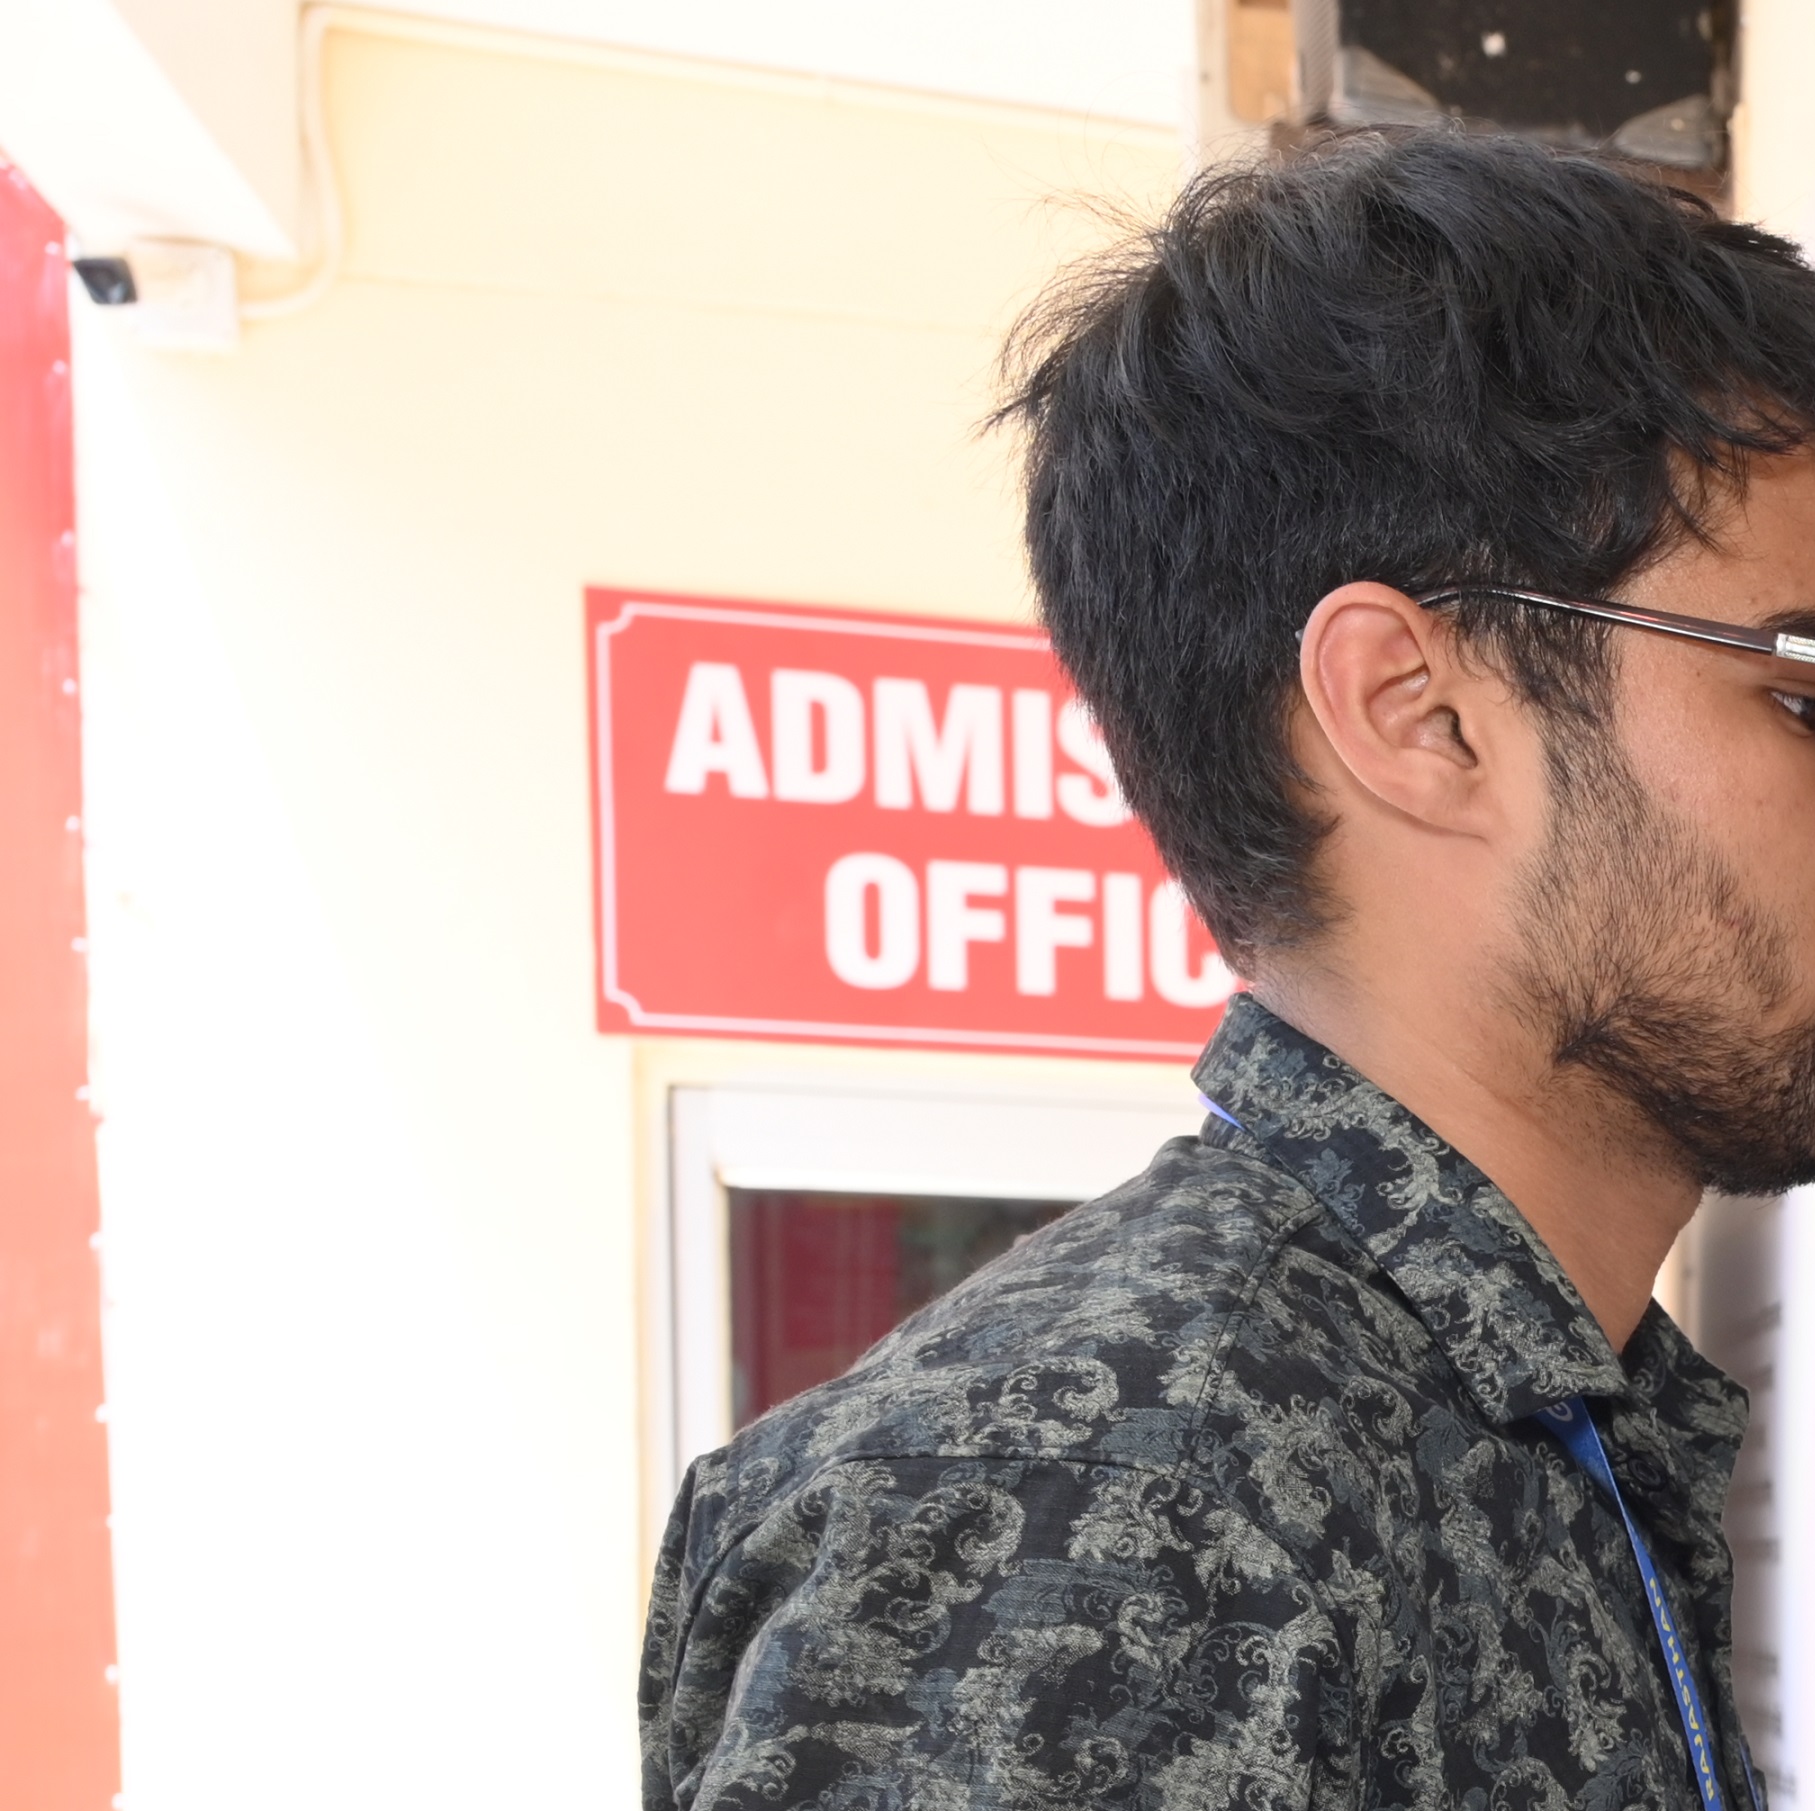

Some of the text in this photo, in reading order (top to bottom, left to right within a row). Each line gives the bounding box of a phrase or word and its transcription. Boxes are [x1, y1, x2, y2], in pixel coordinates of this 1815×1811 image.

[664, 661, 1134, 827] ADMIS
[823, 851, 1240, 1009] OFFIC
[1648, 1577, 1714, 1802] RAJASTHAN
